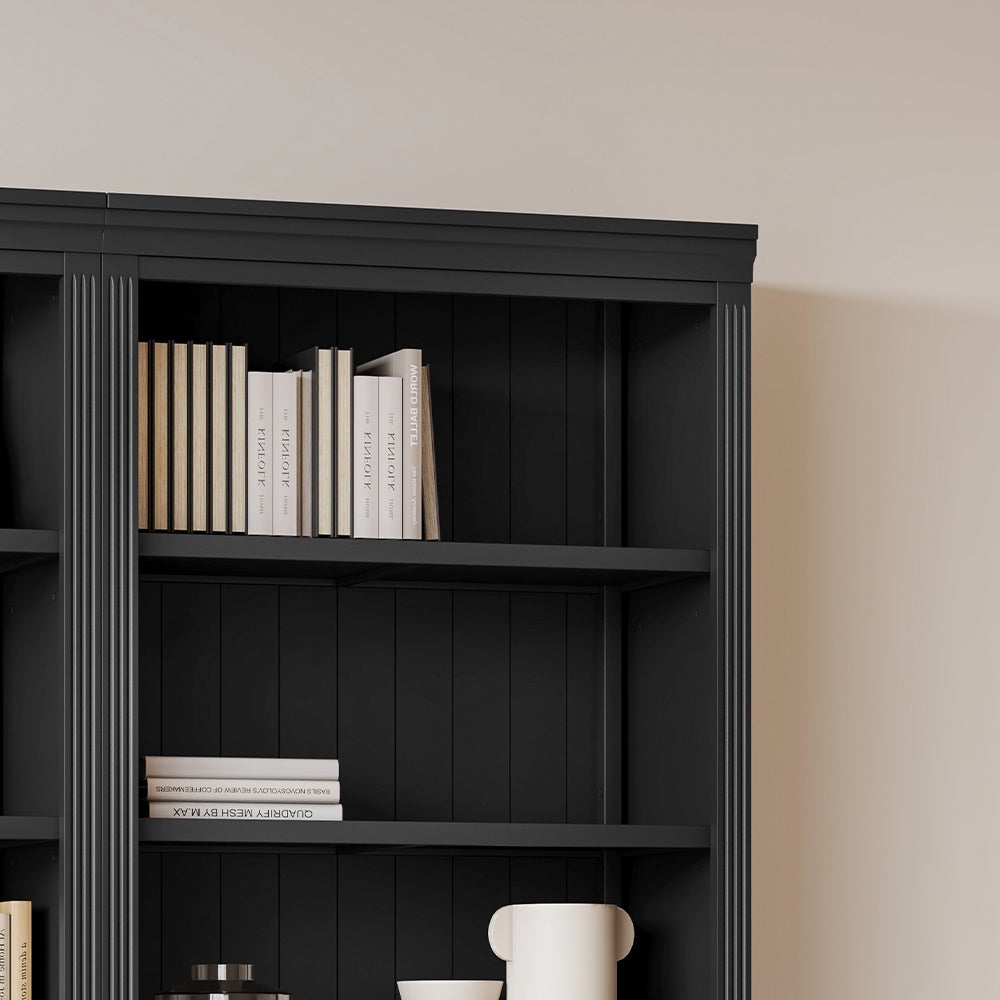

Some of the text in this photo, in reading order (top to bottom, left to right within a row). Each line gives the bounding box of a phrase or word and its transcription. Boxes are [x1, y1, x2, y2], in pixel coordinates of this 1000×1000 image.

[173, 808, 313, 818] QUADRIFY MESH BY M.AX
